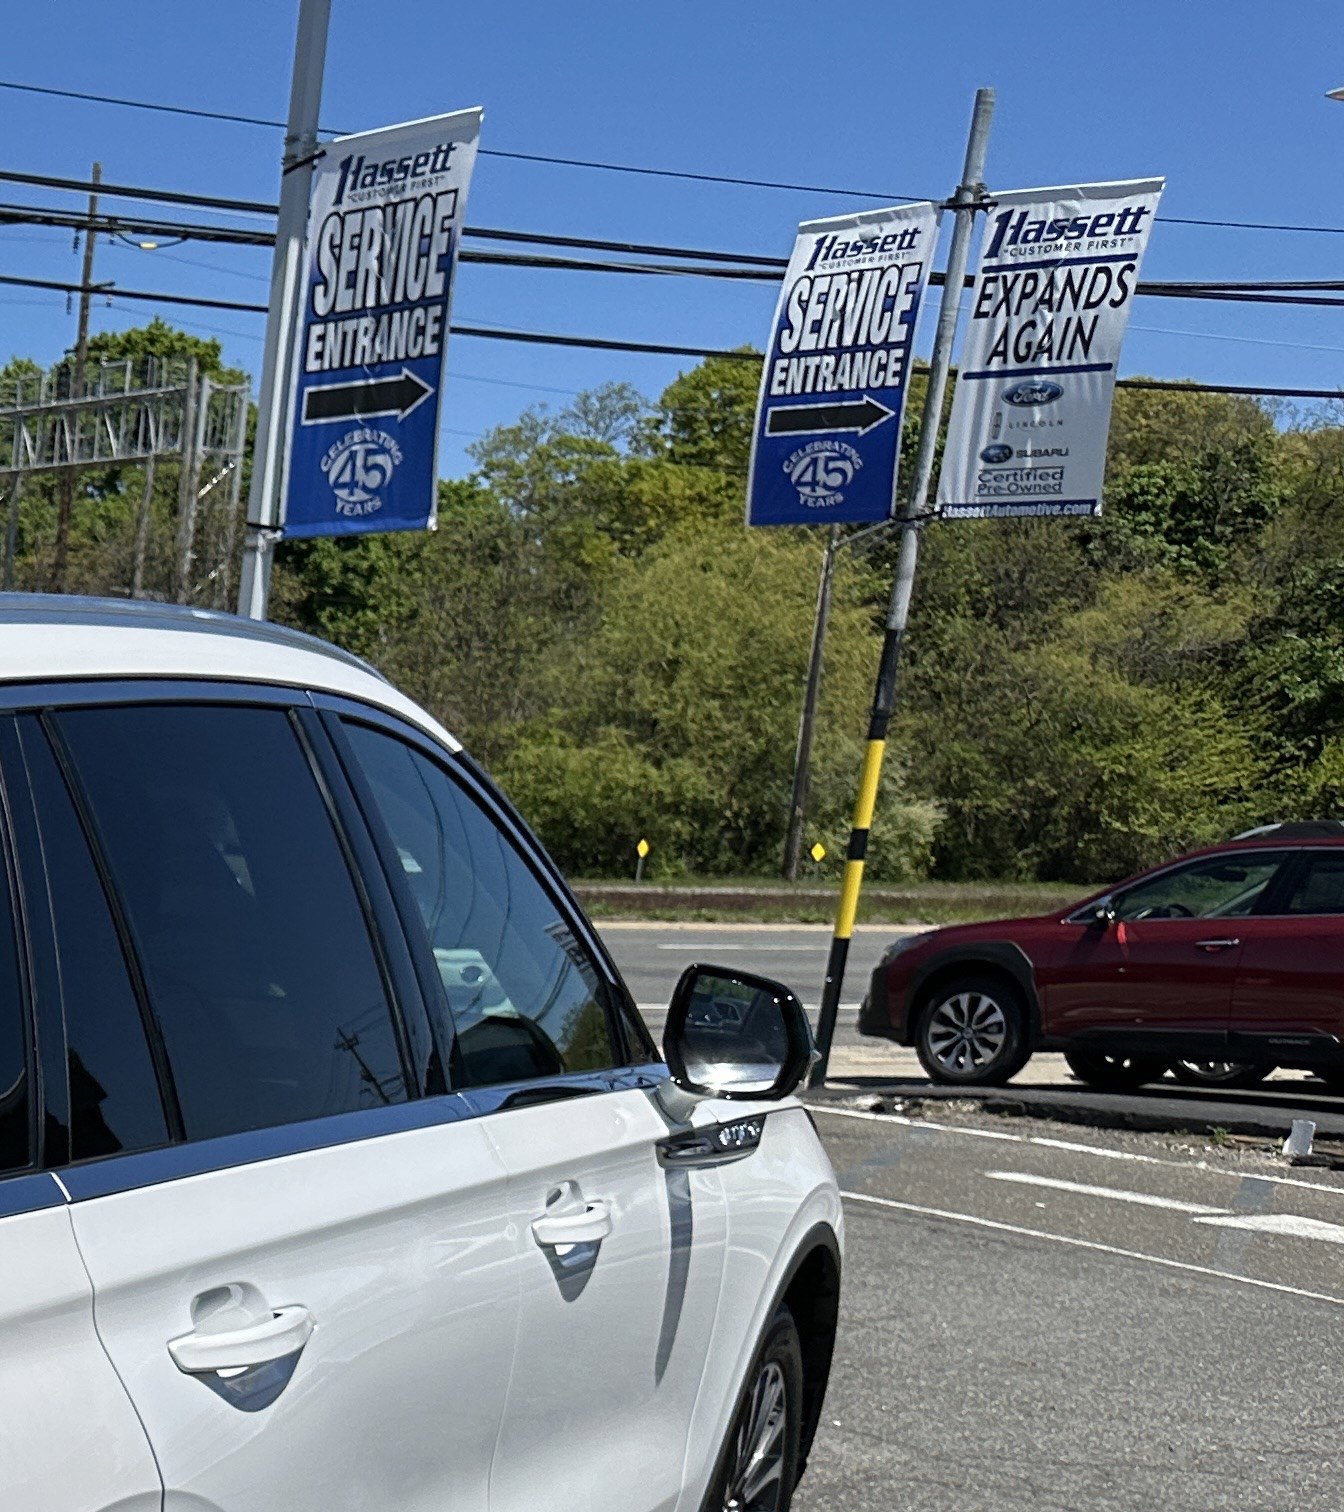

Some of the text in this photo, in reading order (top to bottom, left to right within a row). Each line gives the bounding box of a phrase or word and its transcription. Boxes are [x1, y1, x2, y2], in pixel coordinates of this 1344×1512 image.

[332, 141, 458, 206] Hassett
[313, 190, 458, 318] SERVICE
[804, 227, 922, 271] Hassett
[983, 205, 1151, 259] Hassett
[780, 262, 923, 354] SERVICE
[973, 263, 1136, 319] EXPANDS
[305, 304, 443, 373] ENTRANCE
[985, 314, 1100, 366] AGAIN
[769, 348, 905, 396] ENTRANCE
[1008, 419, 1064, 430] LINCOLN
[320, 428, 403, 473] CELEBRATING
[332, 448, 388, 498] 45
[782, 441, 864, 473] CELEBRATING
[1016, 447, 1069, 458] SUBARU
[793, 456, 850, 494] 45
[977, 469, 1064, 483] Certified
[977, 481, 1063, 495] Pre-Owned
[335, 496, 382, 516] YEARS
[799, 492, 844, 508] YEARS
